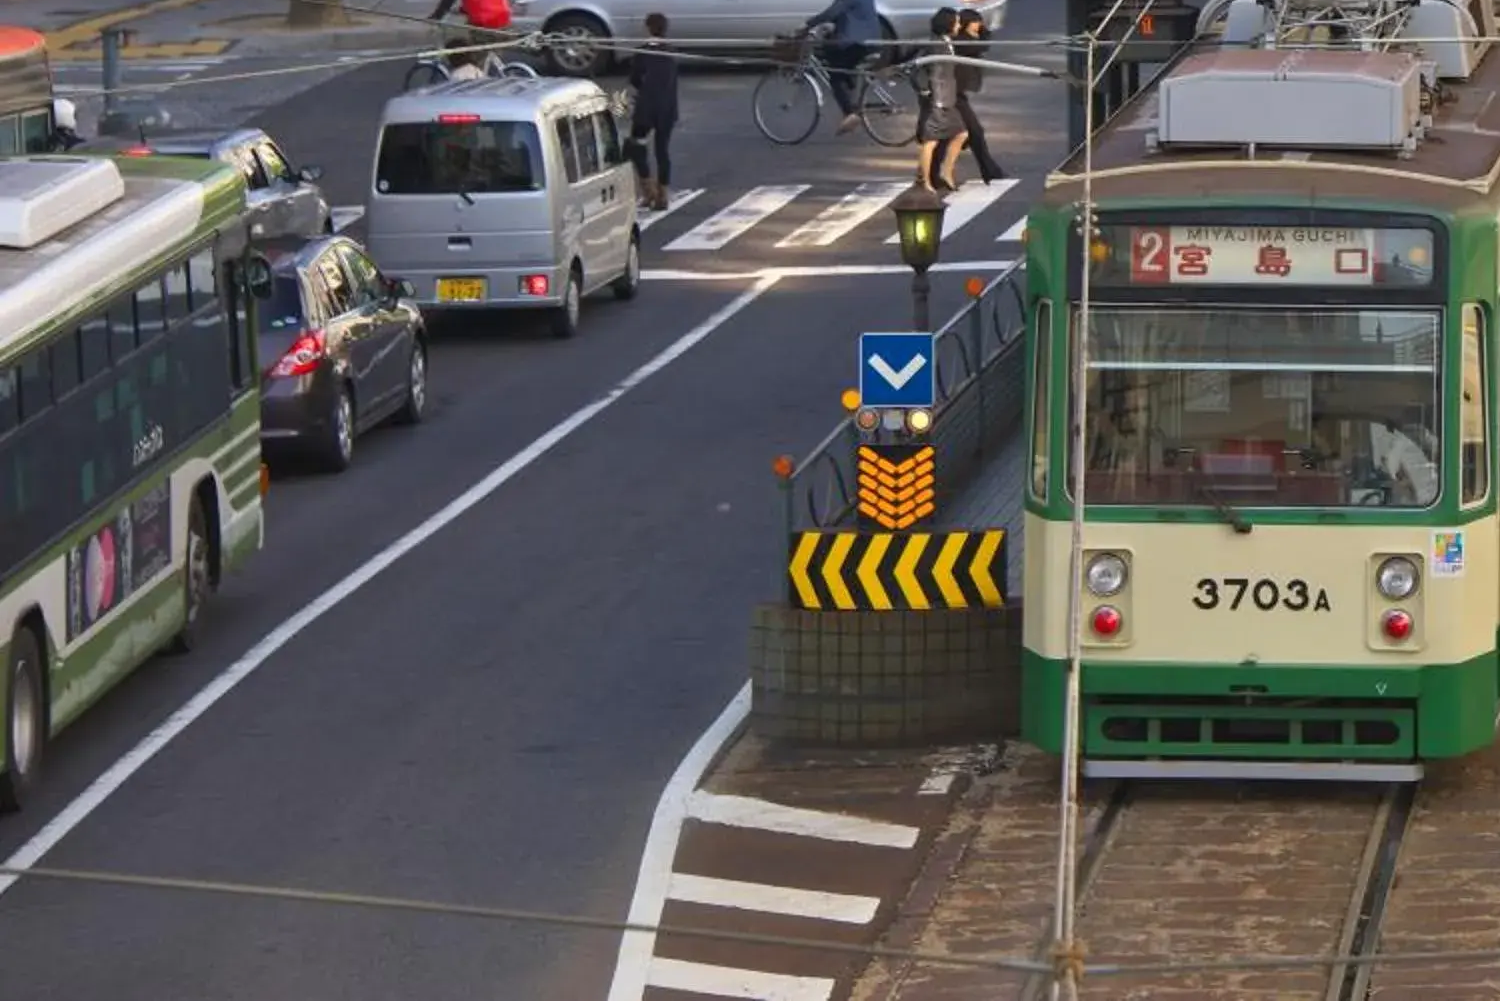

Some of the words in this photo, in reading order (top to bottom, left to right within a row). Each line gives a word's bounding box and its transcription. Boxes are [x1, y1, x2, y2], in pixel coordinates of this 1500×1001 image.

[1138, 229, 1165, 273] 2
[1186, 227, 1287, 243] MIYAJIMA
[1291, 228, 1356, 243] GUCHI
[1173, 244, 1370, 277] 宮島口
[1192, 577, 1332, 613] 3703A
